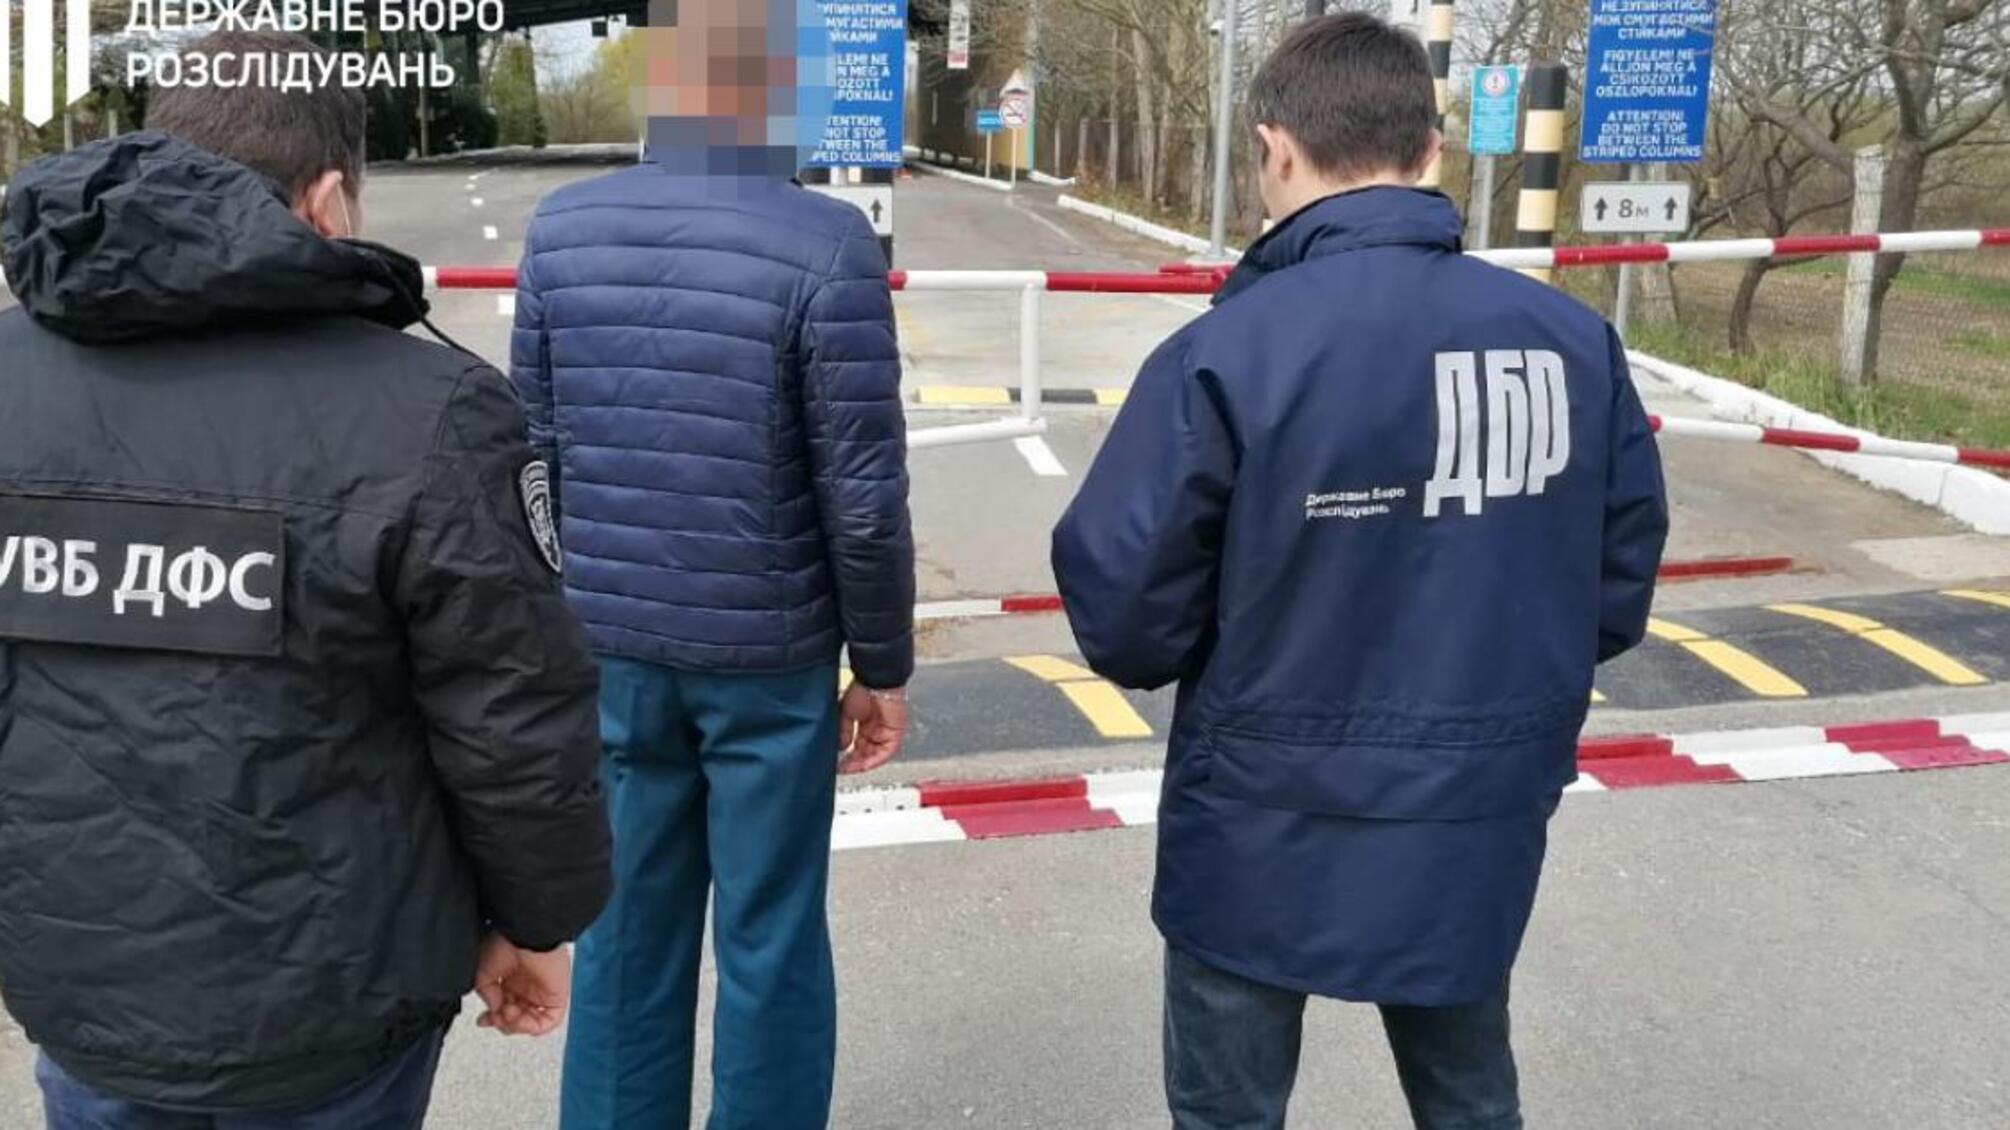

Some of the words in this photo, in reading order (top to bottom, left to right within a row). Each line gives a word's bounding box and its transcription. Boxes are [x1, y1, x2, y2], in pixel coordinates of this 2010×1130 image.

[1655, 61, 1684, 72] MEG
[1606, 110, 1685, 121] ATTENTION!
[853, 127, 887, 139] STOP
[1601, 122, 1620, 134] DO
[1624, 122, 1649, 133] NOT
[1653, 122, 1688, 133] STOP
[865, 139, 888, 150] THE
[1598, 134, 1660, 145] BETWEEN
[1664, 134, 1688, 145] THE
[842, 151, 901, 162] COLUMNS
[1583, 145, 1637, 157] STRIPED
[1639, 145, 1702, 157] COLUMNS
[1423, 349, 1570, 517] ДБР
[113, 543, 275, 616] ДФС
